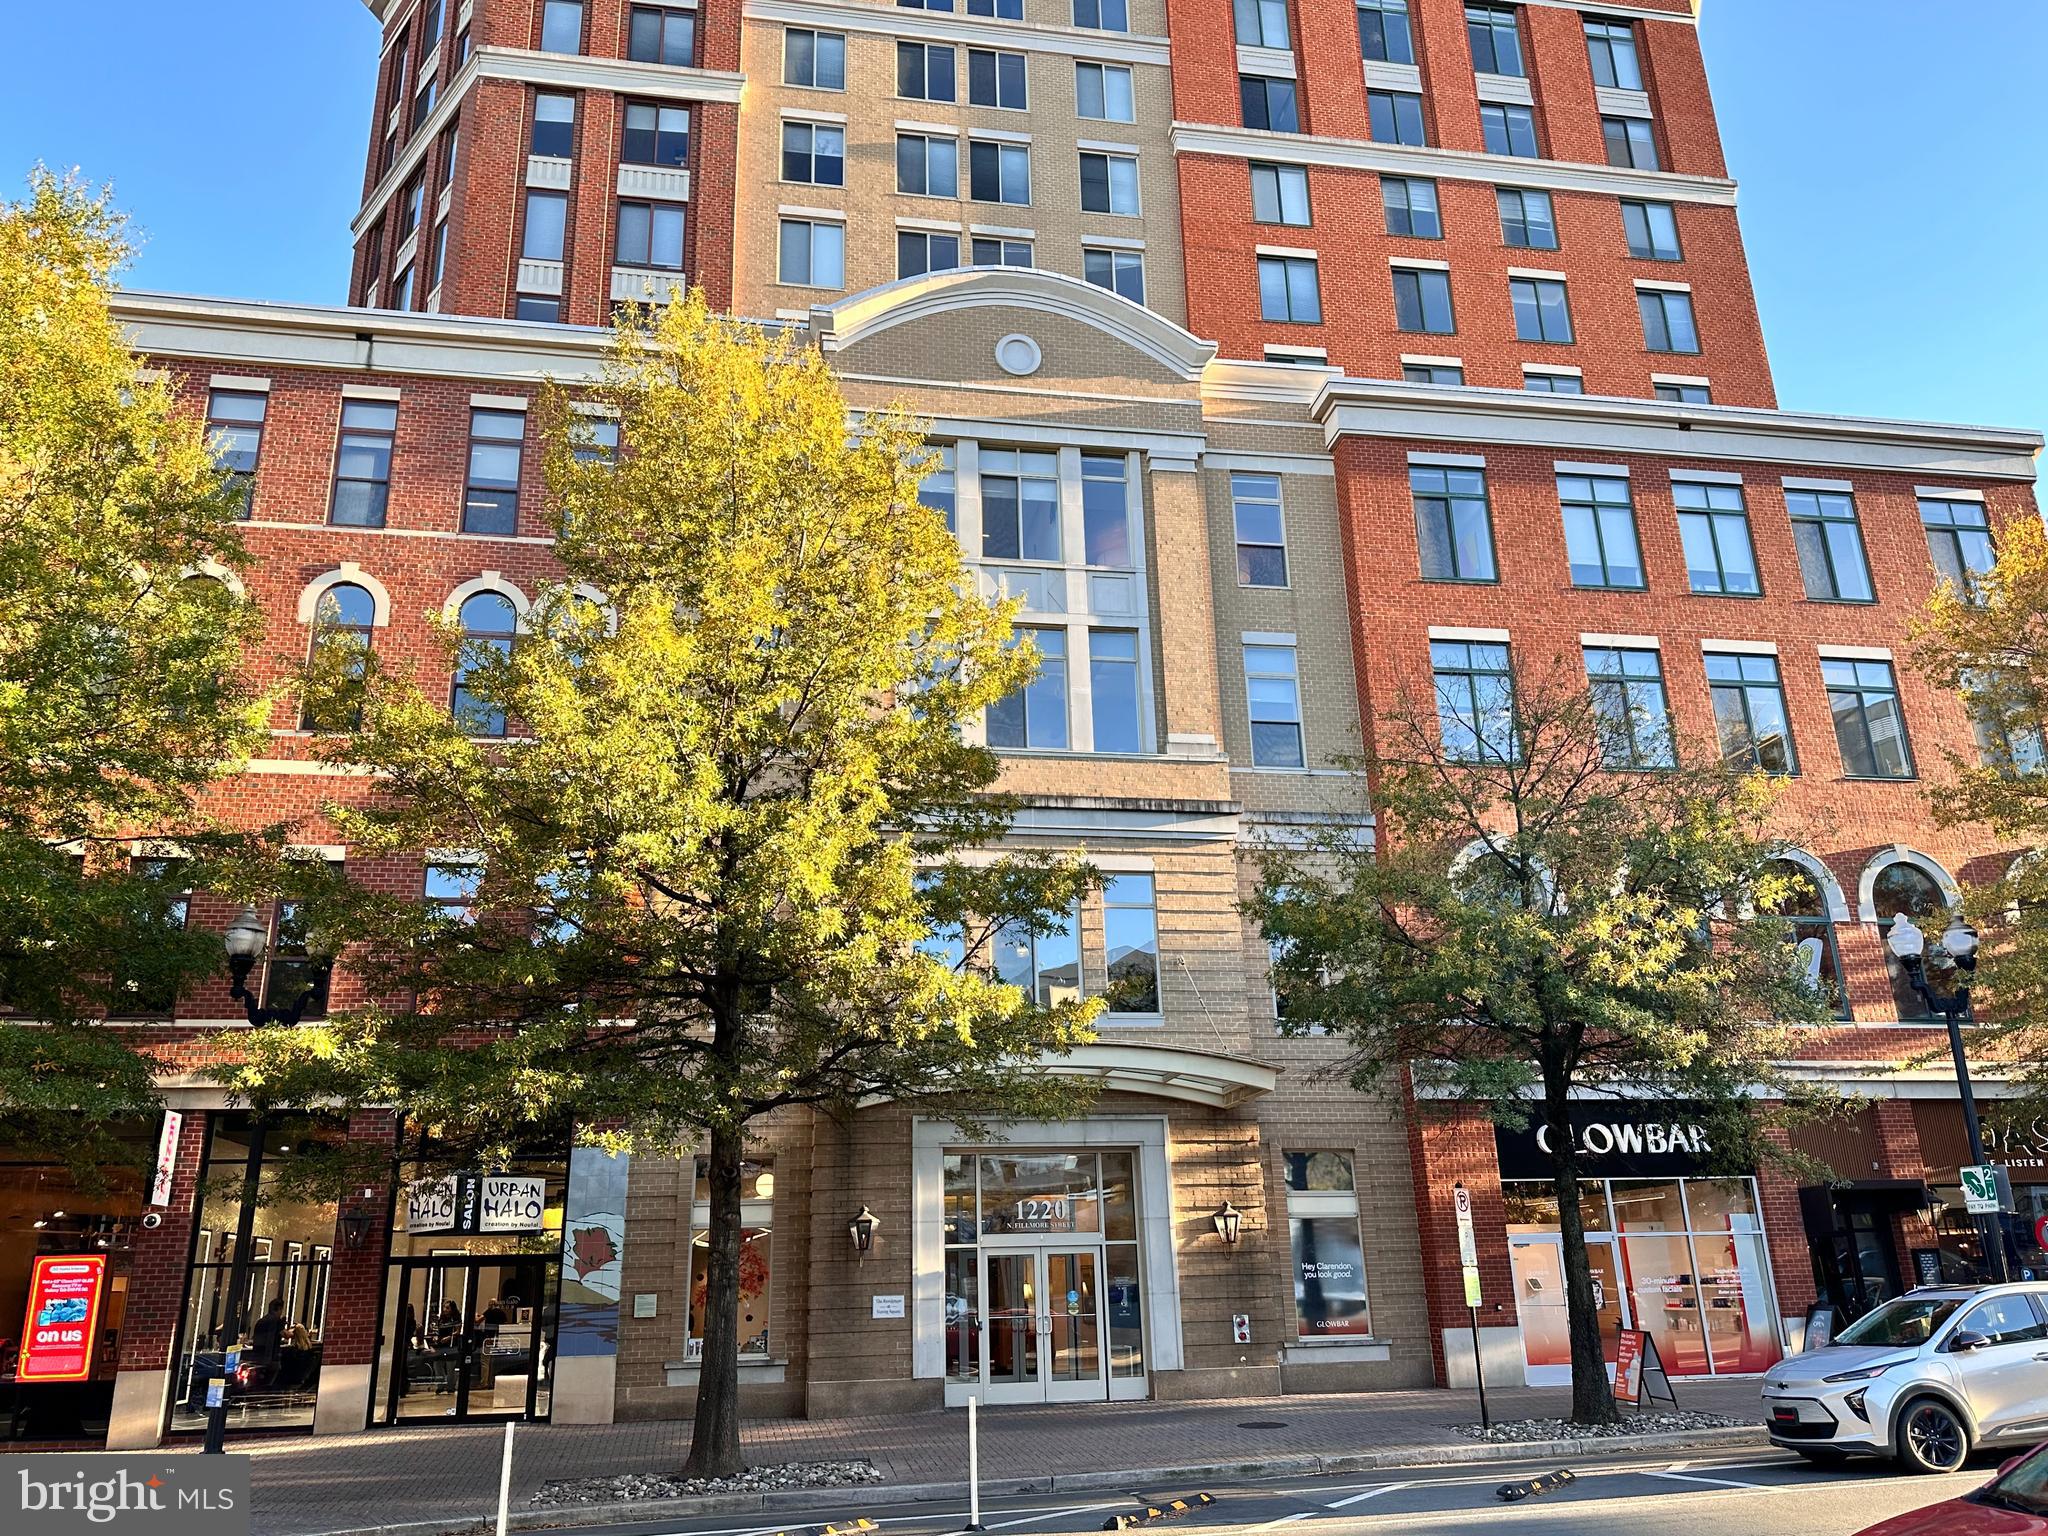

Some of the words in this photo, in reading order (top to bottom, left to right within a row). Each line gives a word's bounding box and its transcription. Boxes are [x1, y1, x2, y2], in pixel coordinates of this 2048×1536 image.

[2005, 1159, 2044, 1167] LISTEN
[1984, 1169, 1992, 1180] 2
[488, 1182, 541, 1197] URBAN
[409, 1199, 453, 1219] HALO
[462, 1178, 476, 1229] SALON
[484, 1198, 541, 1219] HALO
[1016, 1199, 1066, 1220] 1220
[1301, 1262, 1315, 1271] Hey
[1316, 1262, 1354, 1270] Clarendon,
[1304, 1272, 1316, 1280] you
[1317, 1270, 1332, 1278] look
[1333, 1270, 1352, 1279] good.
[1316, 1320, 1350, 1328] GLOWBAR
[36, 1330, 59, 1343] on
[61, 1330, 82, 1342] us
